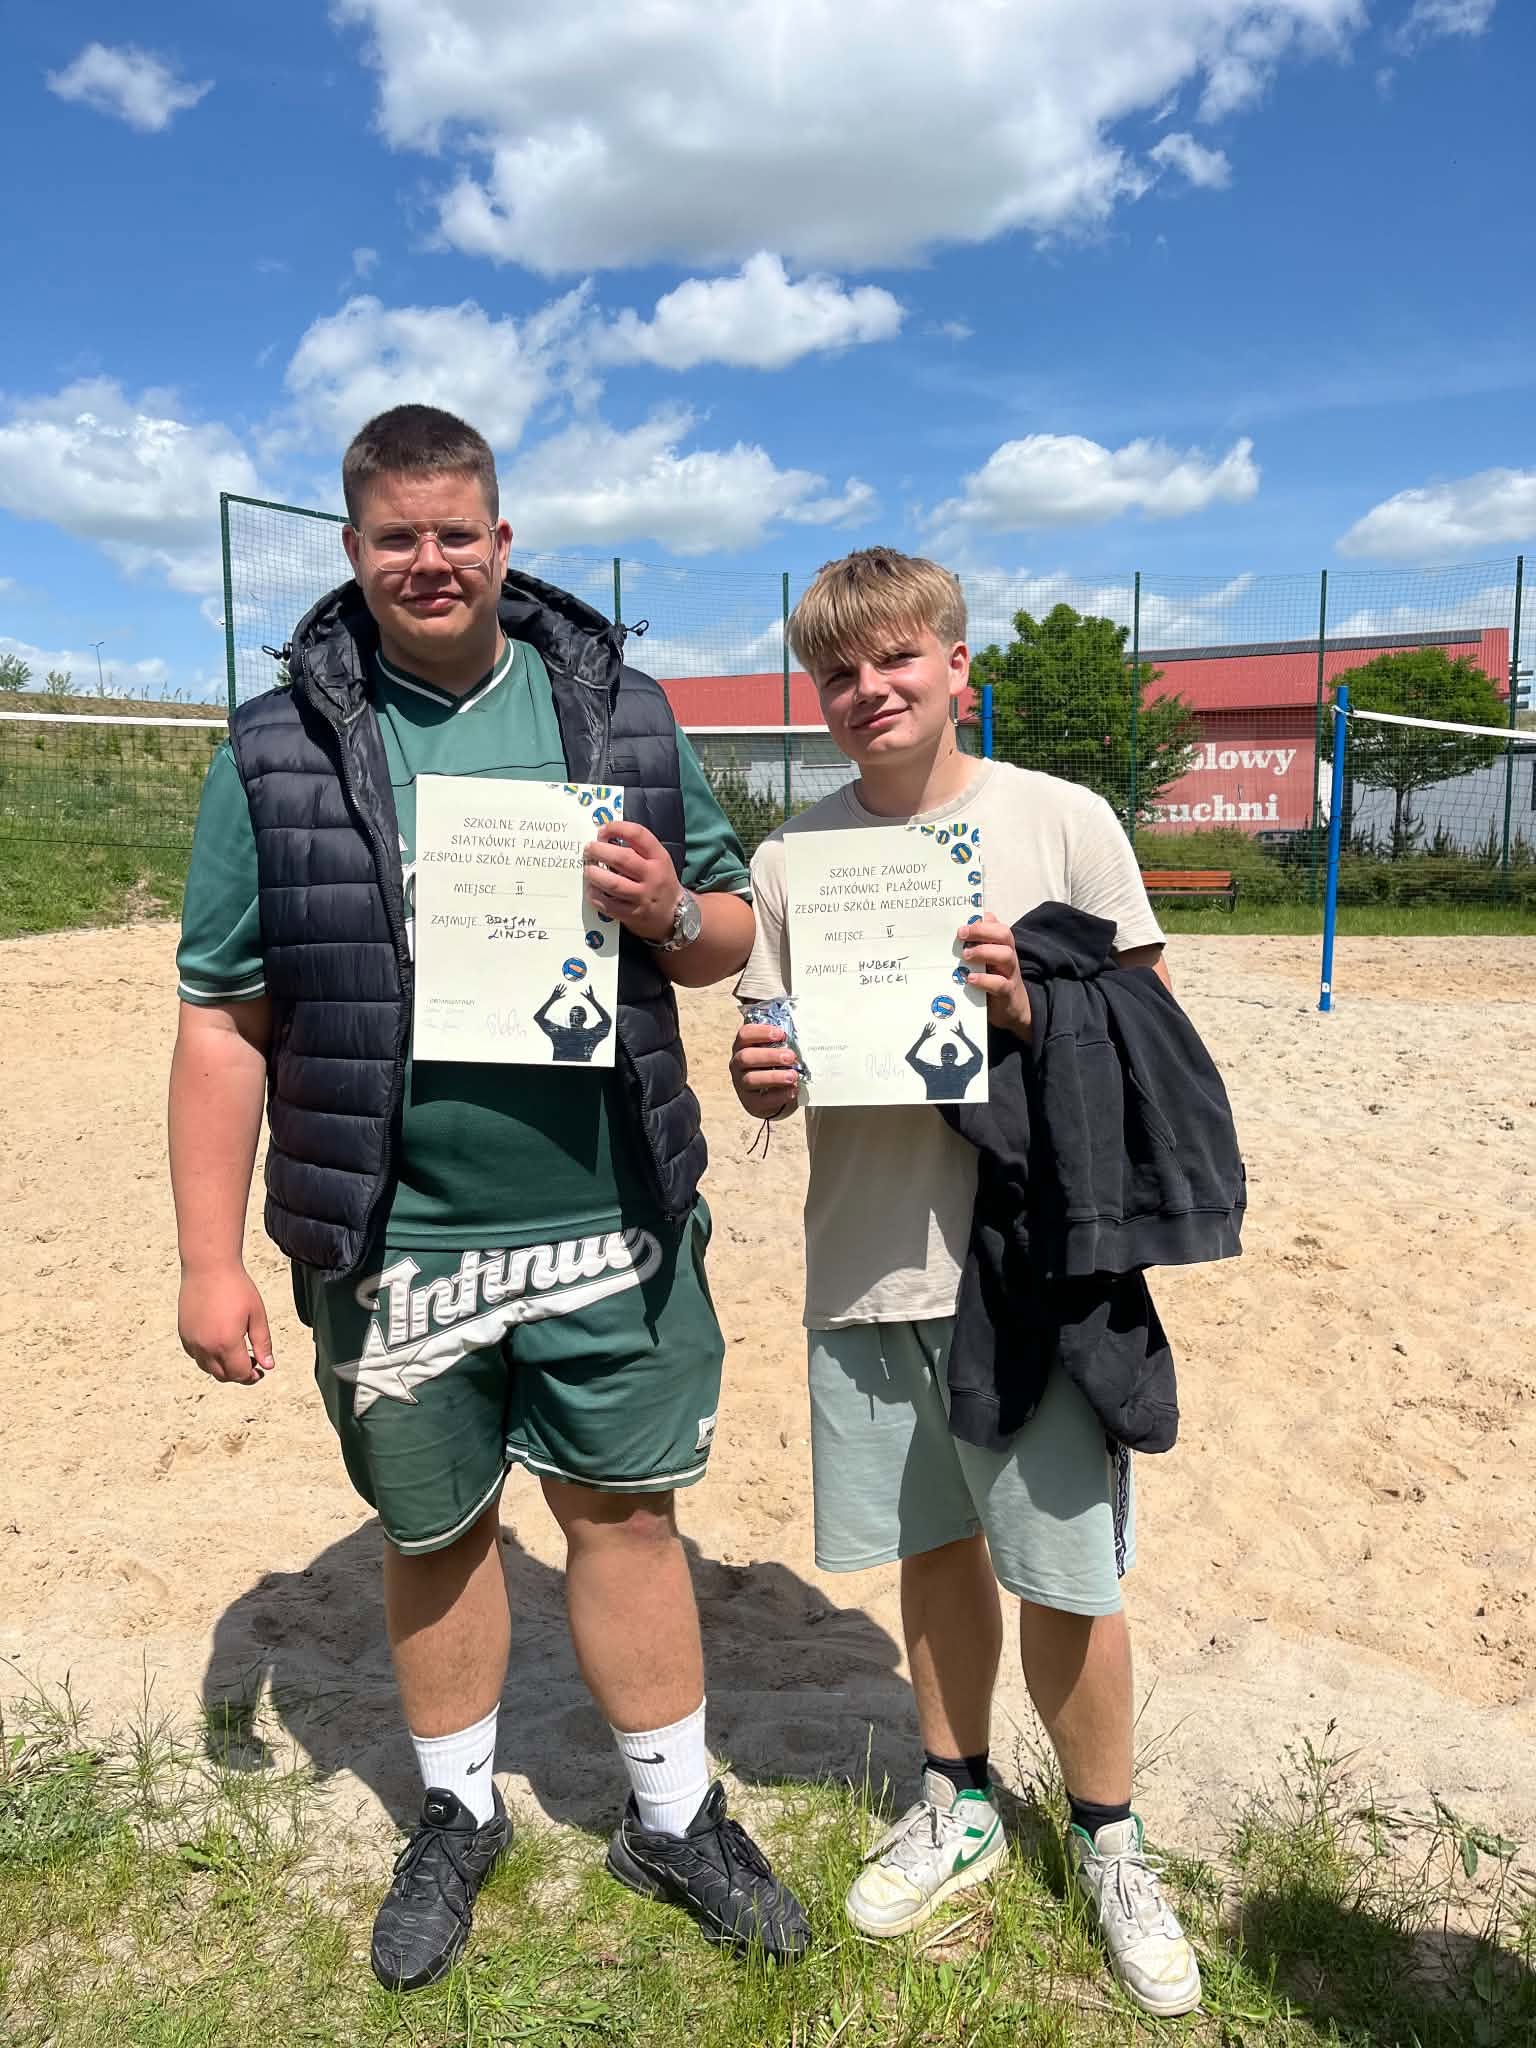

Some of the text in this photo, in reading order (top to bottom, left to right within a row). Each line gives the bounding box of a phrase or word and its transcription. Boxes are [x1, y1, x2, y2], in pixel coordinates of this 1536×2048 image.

[463, 817, 568, 834] SZKOLNE ZAWODY
[451, 834, 516, 849] SIATKÓWKI
[476, 851, 511, 866] SZKÓŁ
[829, 863, 928, 879] SZKOLNE ZAWODY
[453, 882, 497, 897] MIEJSCE
[819, 878, 944, 896] SIATKÓWKI PLAŻOWEJ
[794, 895, 972, 914] ZESPOŁU SZKÓŁ MENEDŻERSKICH
[431, 914, 478, 928] ZAJMUJE
[488, 928, 550, 940] LINDER
[824, 930, 865, 944] MIEJSCE
[805, 955, 911, 977] ZAJMUJE HUBERT
[859, 974, 909, 985] BILICKI
